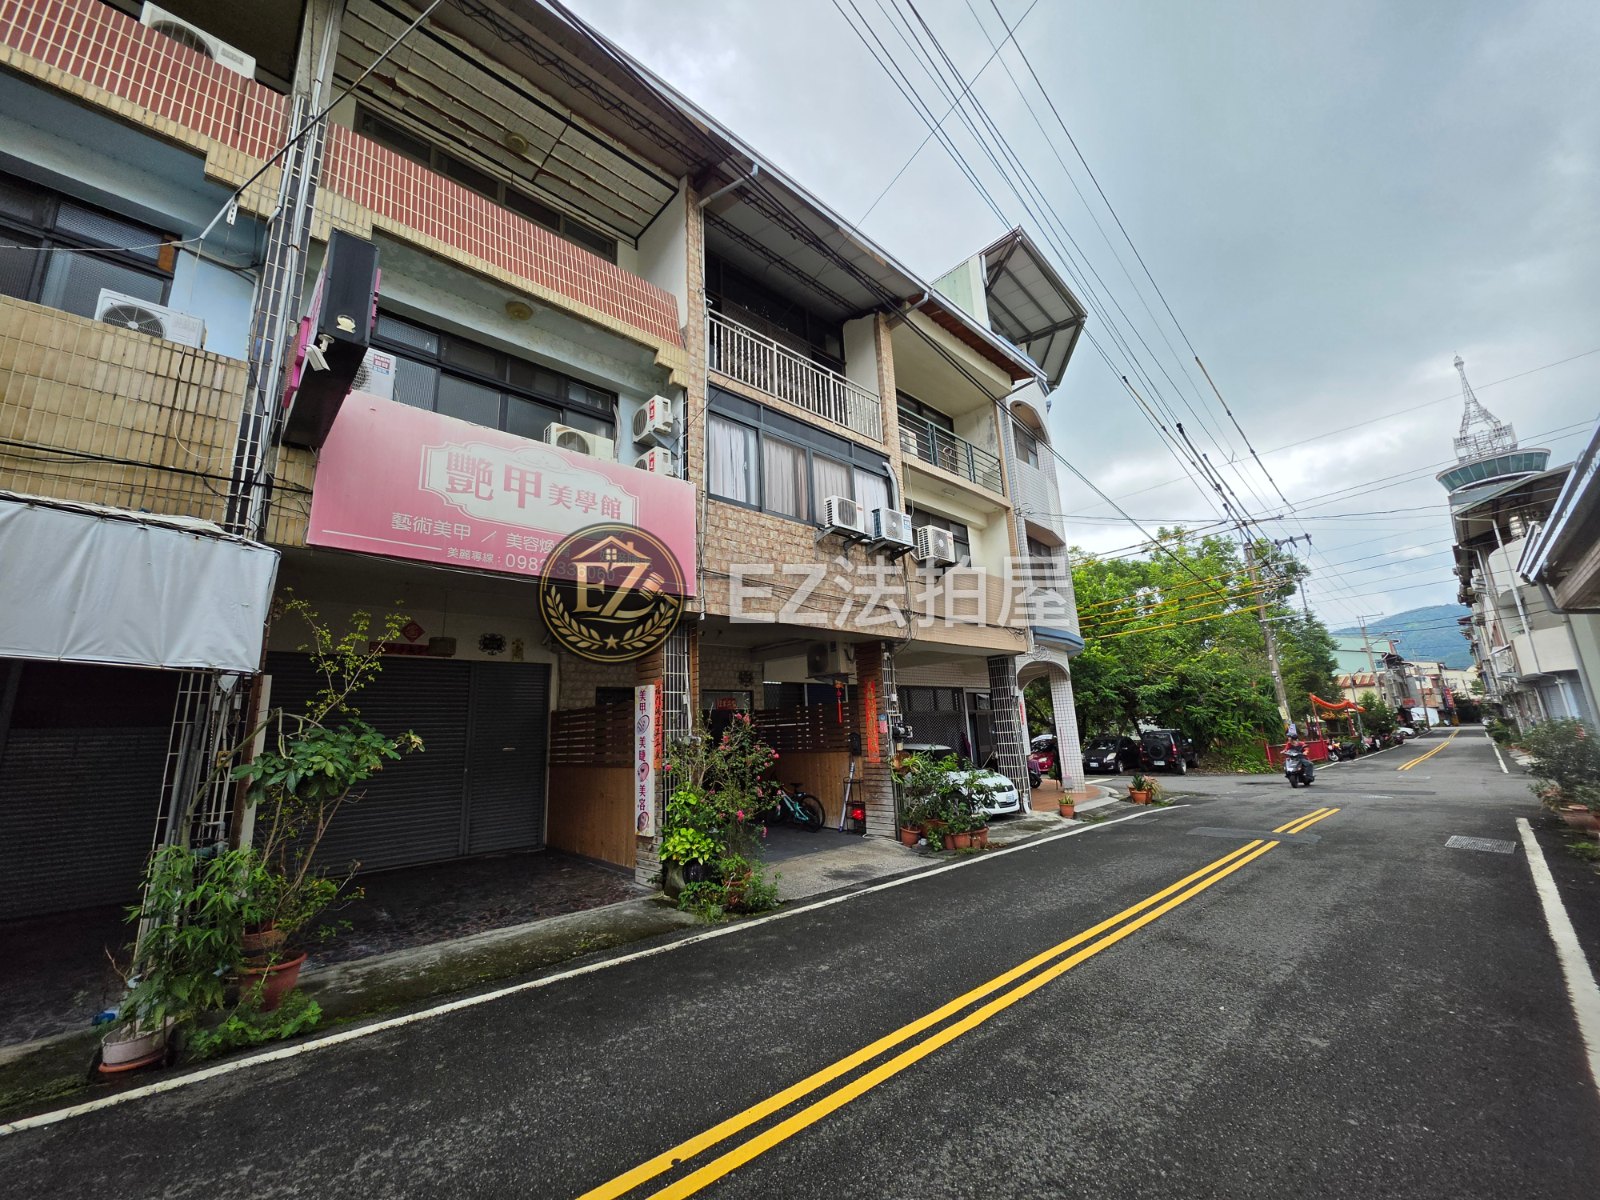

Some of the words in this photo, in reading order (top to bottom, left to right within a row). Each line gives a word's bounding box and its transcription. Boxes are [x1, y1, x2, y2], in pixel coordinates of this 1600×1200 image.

[391, 512, 471, 541] 藝術美甲
[639, 690, 646, 714] 美甲
